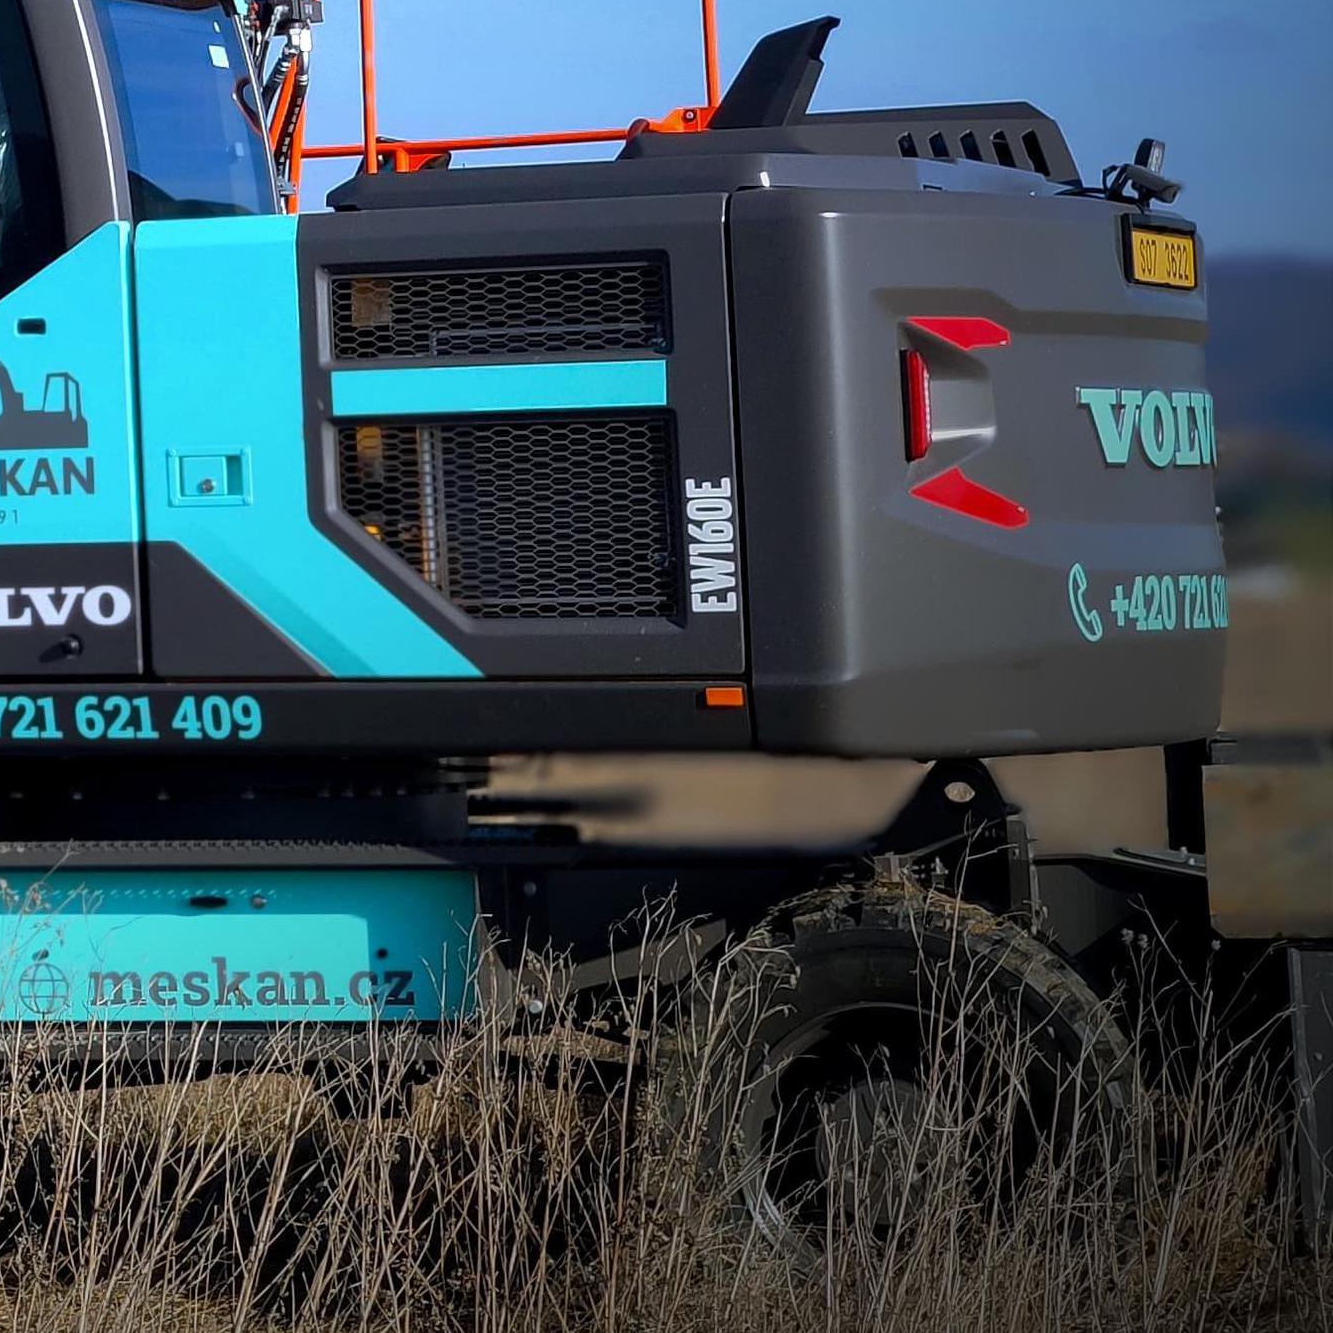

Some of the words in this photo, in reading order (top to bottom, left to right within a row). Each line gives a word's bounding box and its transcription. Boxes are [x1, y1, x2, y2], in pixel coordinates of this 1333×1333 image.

[1165, 241, 1189, 281] 3622
[1075, 386, 1217, 466] VOLV
[685, 477, 737, 612] EW160E
[1110, 575, 1176, 631] +420
[1179, 575, 1211, 629] 721
[75, 696, 159, 739] 621
[172, 695, 262, 739] 409
[89, 957, 415, 1007] meskan.cz
